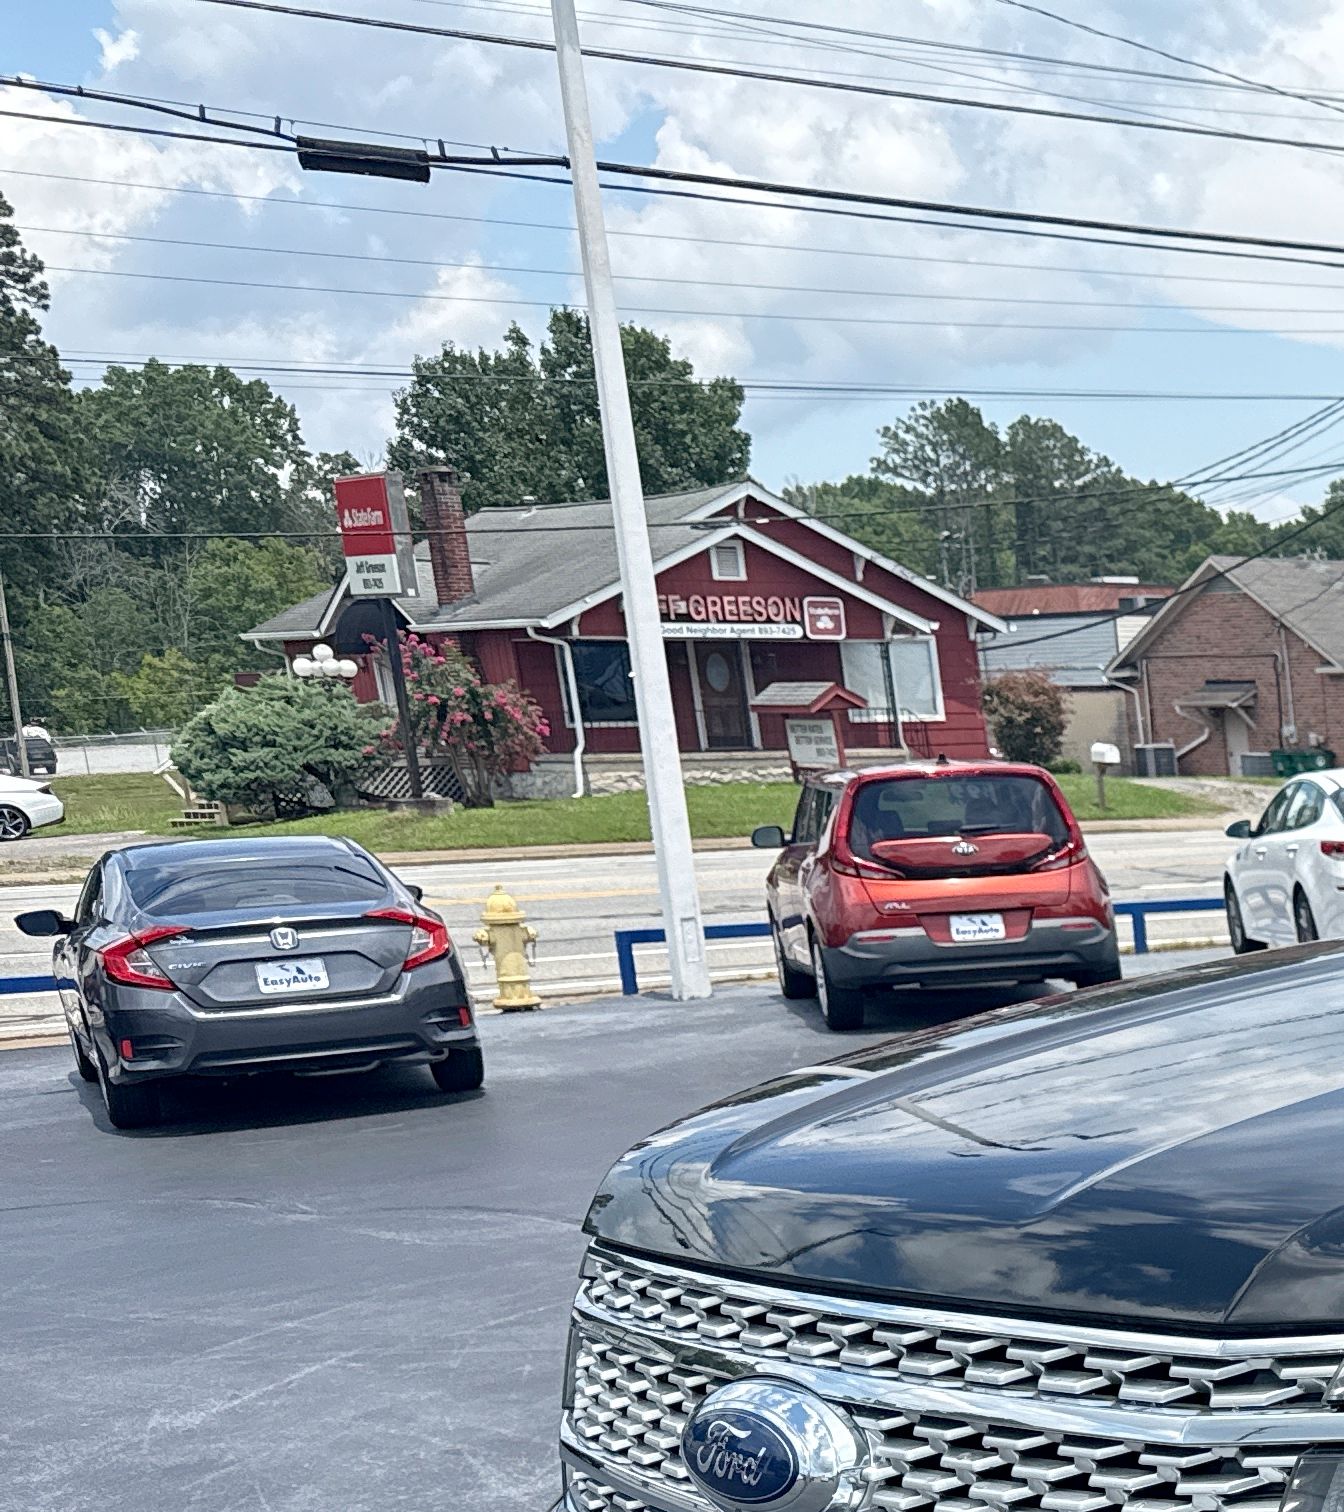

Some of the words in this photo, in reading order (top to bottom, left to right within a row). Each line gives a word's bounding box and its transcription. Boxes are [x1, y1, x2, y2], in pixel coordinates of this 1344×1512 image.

[688, 595, 801, 621] GREESON
[168, 962, 206, 970] CIVIC
[263, 974, 322, 988] EasyAuto
[697, 1420, 767, 1487] Ford
